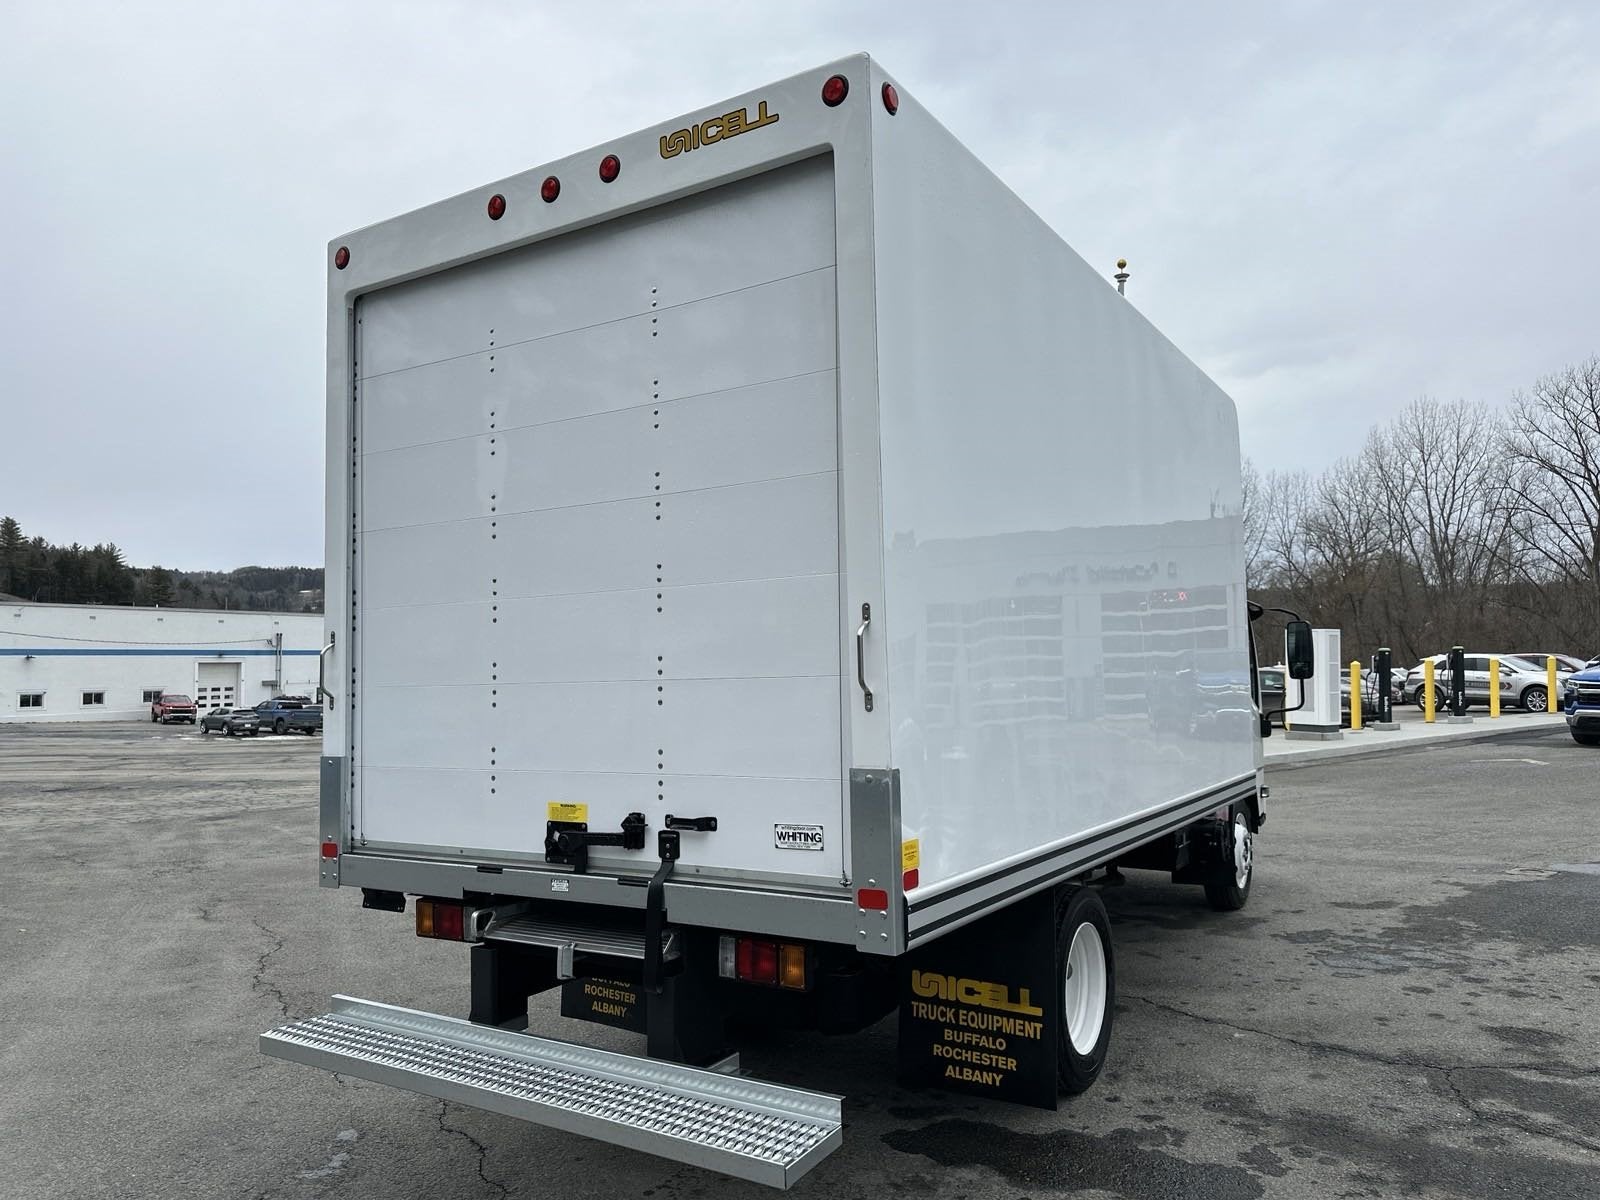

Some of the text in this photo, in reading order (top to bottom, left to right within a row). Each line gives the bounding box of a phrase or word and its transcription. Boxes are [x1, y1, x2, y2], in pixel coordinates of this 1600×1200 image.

[659, 100, 780, 160] UNICELL
[776, 830, 822, 843] WHITING
[584, 983, 636, 1005] ROCHESTER
[911, 969, 1043, 1017] UNICELL
[591, 1000, 627, 1018] ALBANY
[911, 1001, 1043, 1040] TRUCK EQUIPMENT
[944, 1028, 1007, 1051] BUFFALO
[933, 1043, 1017, 1071] ROCHESTER
[944, 1064, 1004, 1087] ALBANY
